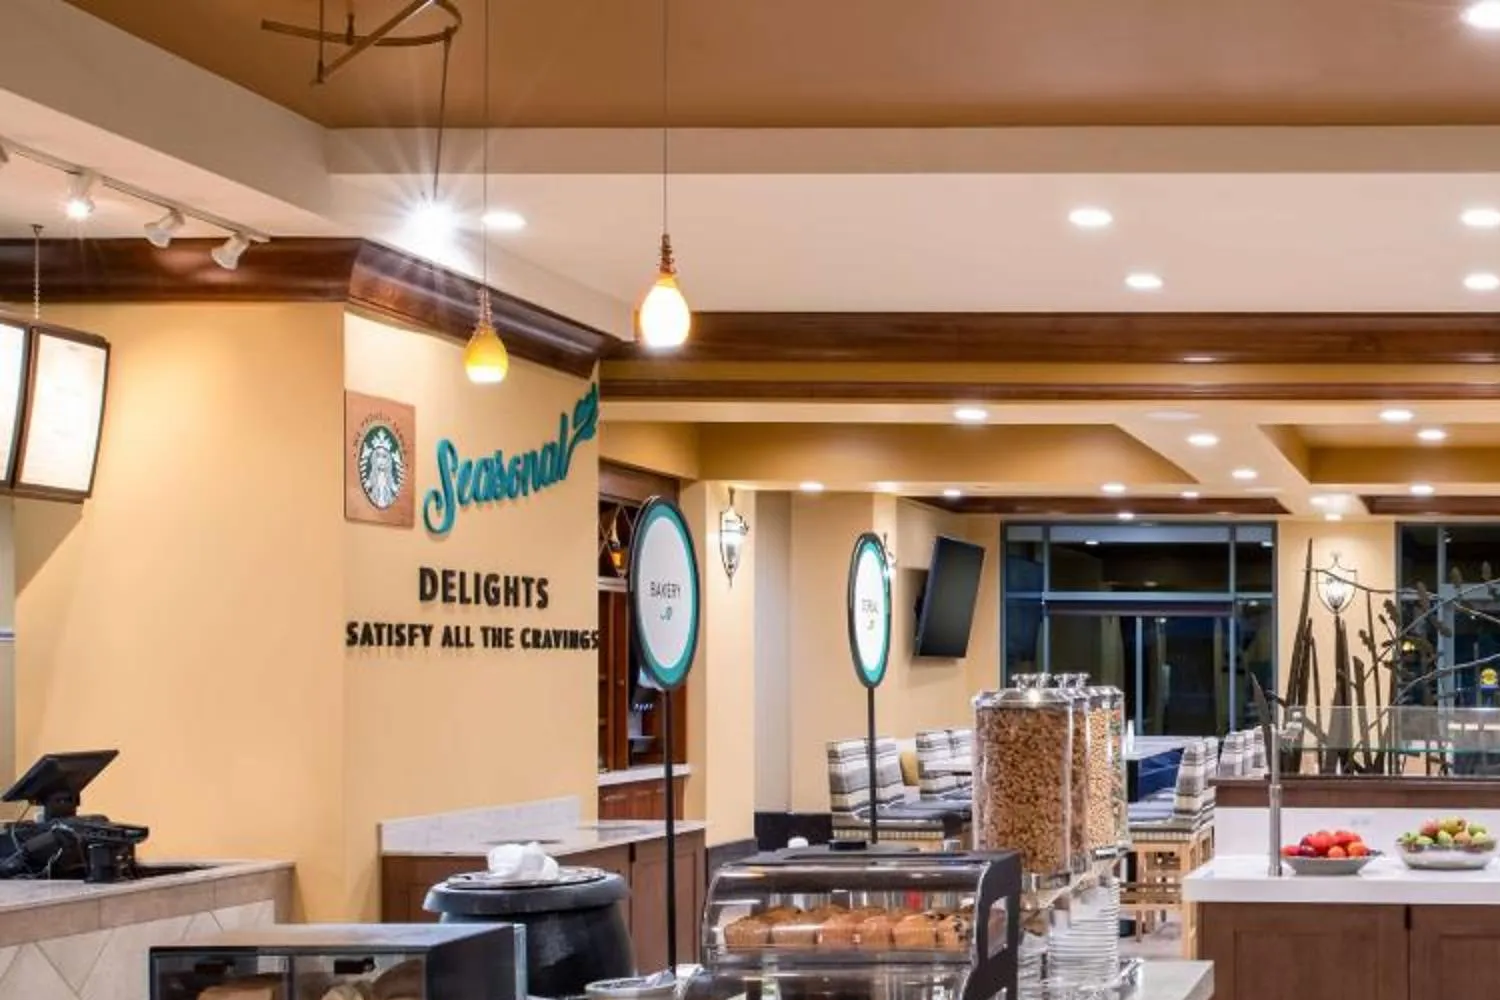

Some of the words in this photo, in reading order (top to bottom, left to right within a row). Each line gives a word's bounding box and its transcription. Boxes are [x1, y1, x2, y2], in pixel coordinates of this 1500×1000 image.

[423, 412, 572, 534] Seasonal
[418, 566, 549, 609] DELIGHTS
[650, 580, 681, 598] BAKERY
[345, 621, 434, 647] SATISFY
[441, 625, 475, 649] ALL
[480, 626, 515, 649] THE
[520, 627, 599, 650] CRAVINGS
